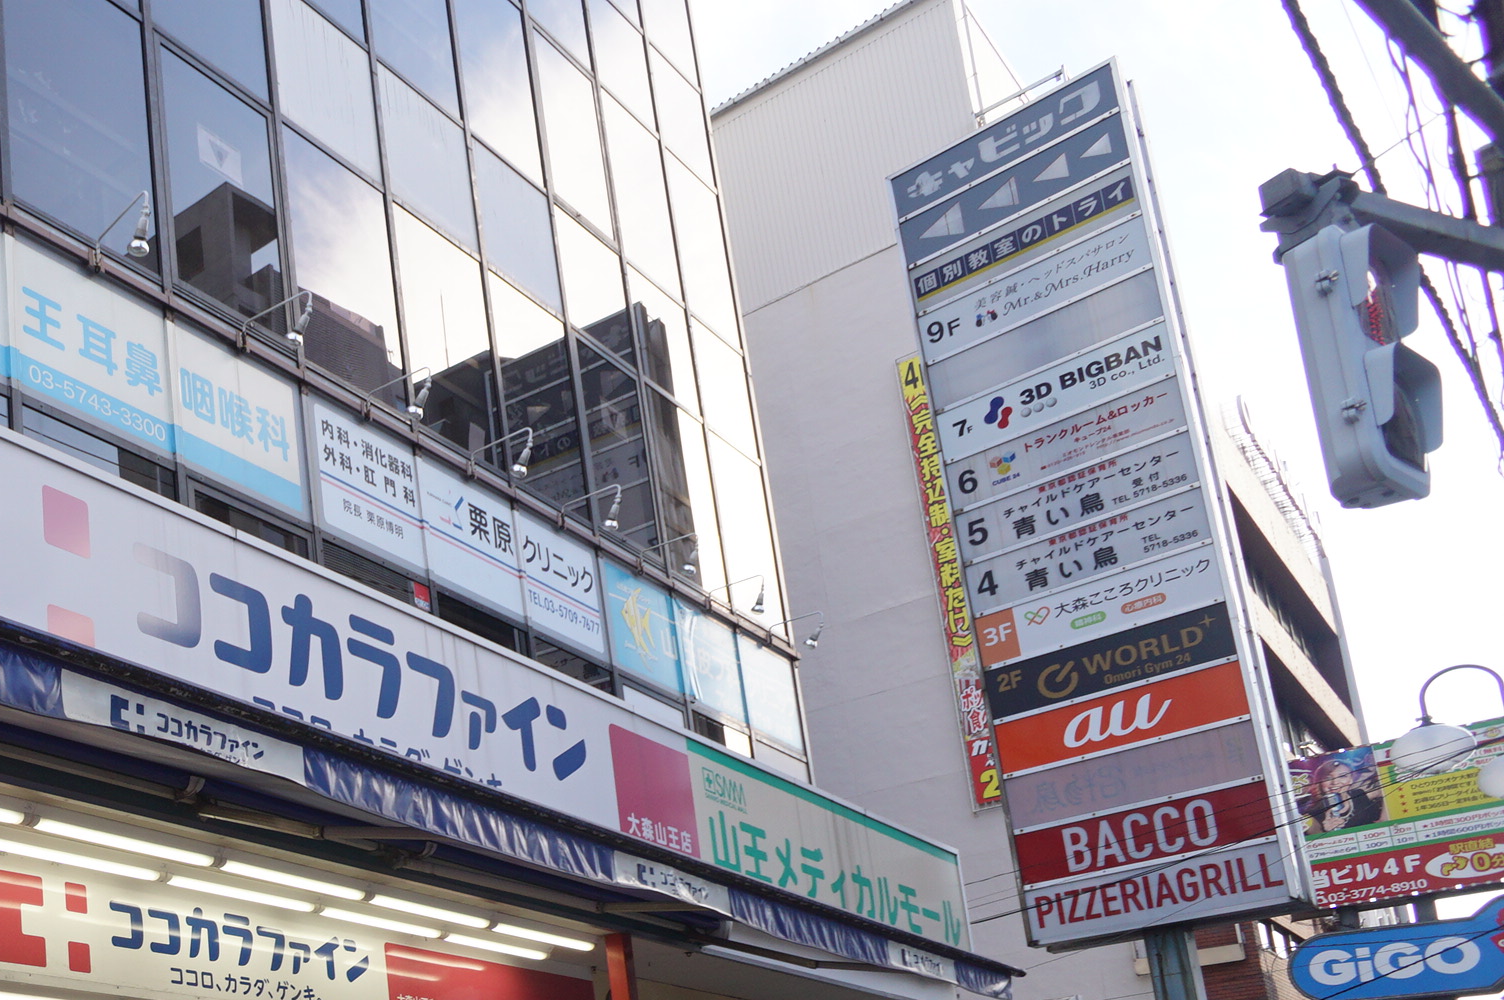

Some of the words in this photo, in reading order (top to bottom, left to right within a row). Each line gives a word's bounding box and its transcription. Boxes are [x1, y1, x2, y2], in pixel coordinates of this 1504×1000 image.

[907, 80, 1101, 198] キャビック
[916, 179, 1128, 295] 個別教室のトライ
[926, 317, 961, 344] 9F
[1019, 382, 1052, 407] 3D
[1059, 335, 1163, 391] BIGBAN
[1088, 375, 1108, 391] 3D
[1139, 354, 1166, 372] Ltd.
[27, 363, 167, 443] 03-5743-3300
[1023, 391, 1168, 453] トランクルーム&ロッカー
[320, 418, 414, 483] 内科・消化器科
[951, 418, 974, 439] 7F
[322, 446, 417, 508] 外科・肛門科
[958, 469, 978, 494] 6
[992, 475, 1011, 487] CUBE
[1002, 450, 1180, 518] チャイルドケアーセンター
[1112, 494, 1131, 506] TEL
[1132, 473, 1189, 499] 5718-5336
[1131, 471, 1160, 488] 受付
[342, 498, 363, 520] 院長
[967, 517, 988, 546] 5
[1012, 492, 1105, 539] 青い鳥
[468, 502, 596, 594] 栗原クリニック
[1015, 505, 1195, 571] チャイルドケアーセンター
[1142, 532, 1161, 544] TEL
[1142, 529, 1199, 554] 5718-5336
[977, 569, 998, 596] 4
[1024, 545, 1119, 592] 青い鳥
[1054, 558, 1211, 619] 大森こころクリニック
[527, 588, 601, 636] TEL.03-5709-7677
[982, 621, 1013, 647] 3F
[136, 541, 588, 782] ココカラファイン
[997, 669, 1023, 693] 2F
[1082, 624, 1204, 675] WORLD
[1103, 663, 1142, 685] Omori
[1144, 658, 1172, 680] Gym
[1172, 652, 1192, 668] 24
[156, 711, 265, 761] ココカラファイン
[1063, 692, 1173, 749] au
[626, 811, 693, 854] 大森山王店
[1062, 798, 1219, 873] BACCO
[708, 809, 962, 947] 山王メディカルモール
[1034, 852, 1285, 930] PIZZERIAGRILL
[1327, 878, 1428, 904] 03-3774-8910
[109, 899, 371, 984] ココカラファイン
[1309, 936, 1481, 987] GiGO
